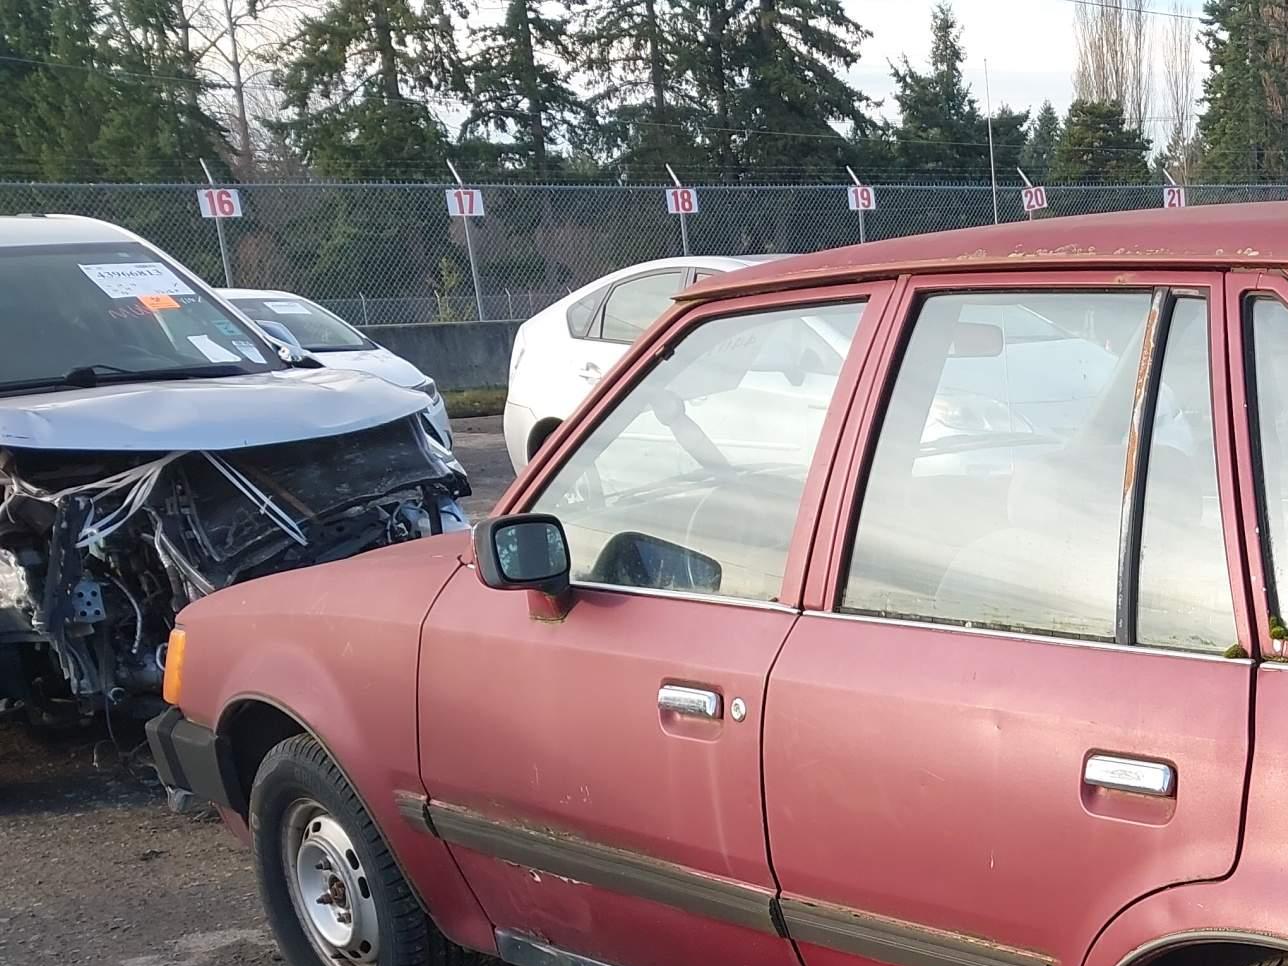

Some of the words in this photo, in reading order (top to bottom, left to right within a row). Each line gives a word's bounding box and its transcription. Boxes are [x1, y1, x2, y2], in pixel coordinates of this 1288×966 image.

[204, 189, 235, 216] 16
[453, 190, 475, 214] 17
[670, 189, 694, 213] 18
[851, 187, 872, 208] 19
[1023, 187, 1045, 210] 20
[1167, 189, 1182, 208] 21
